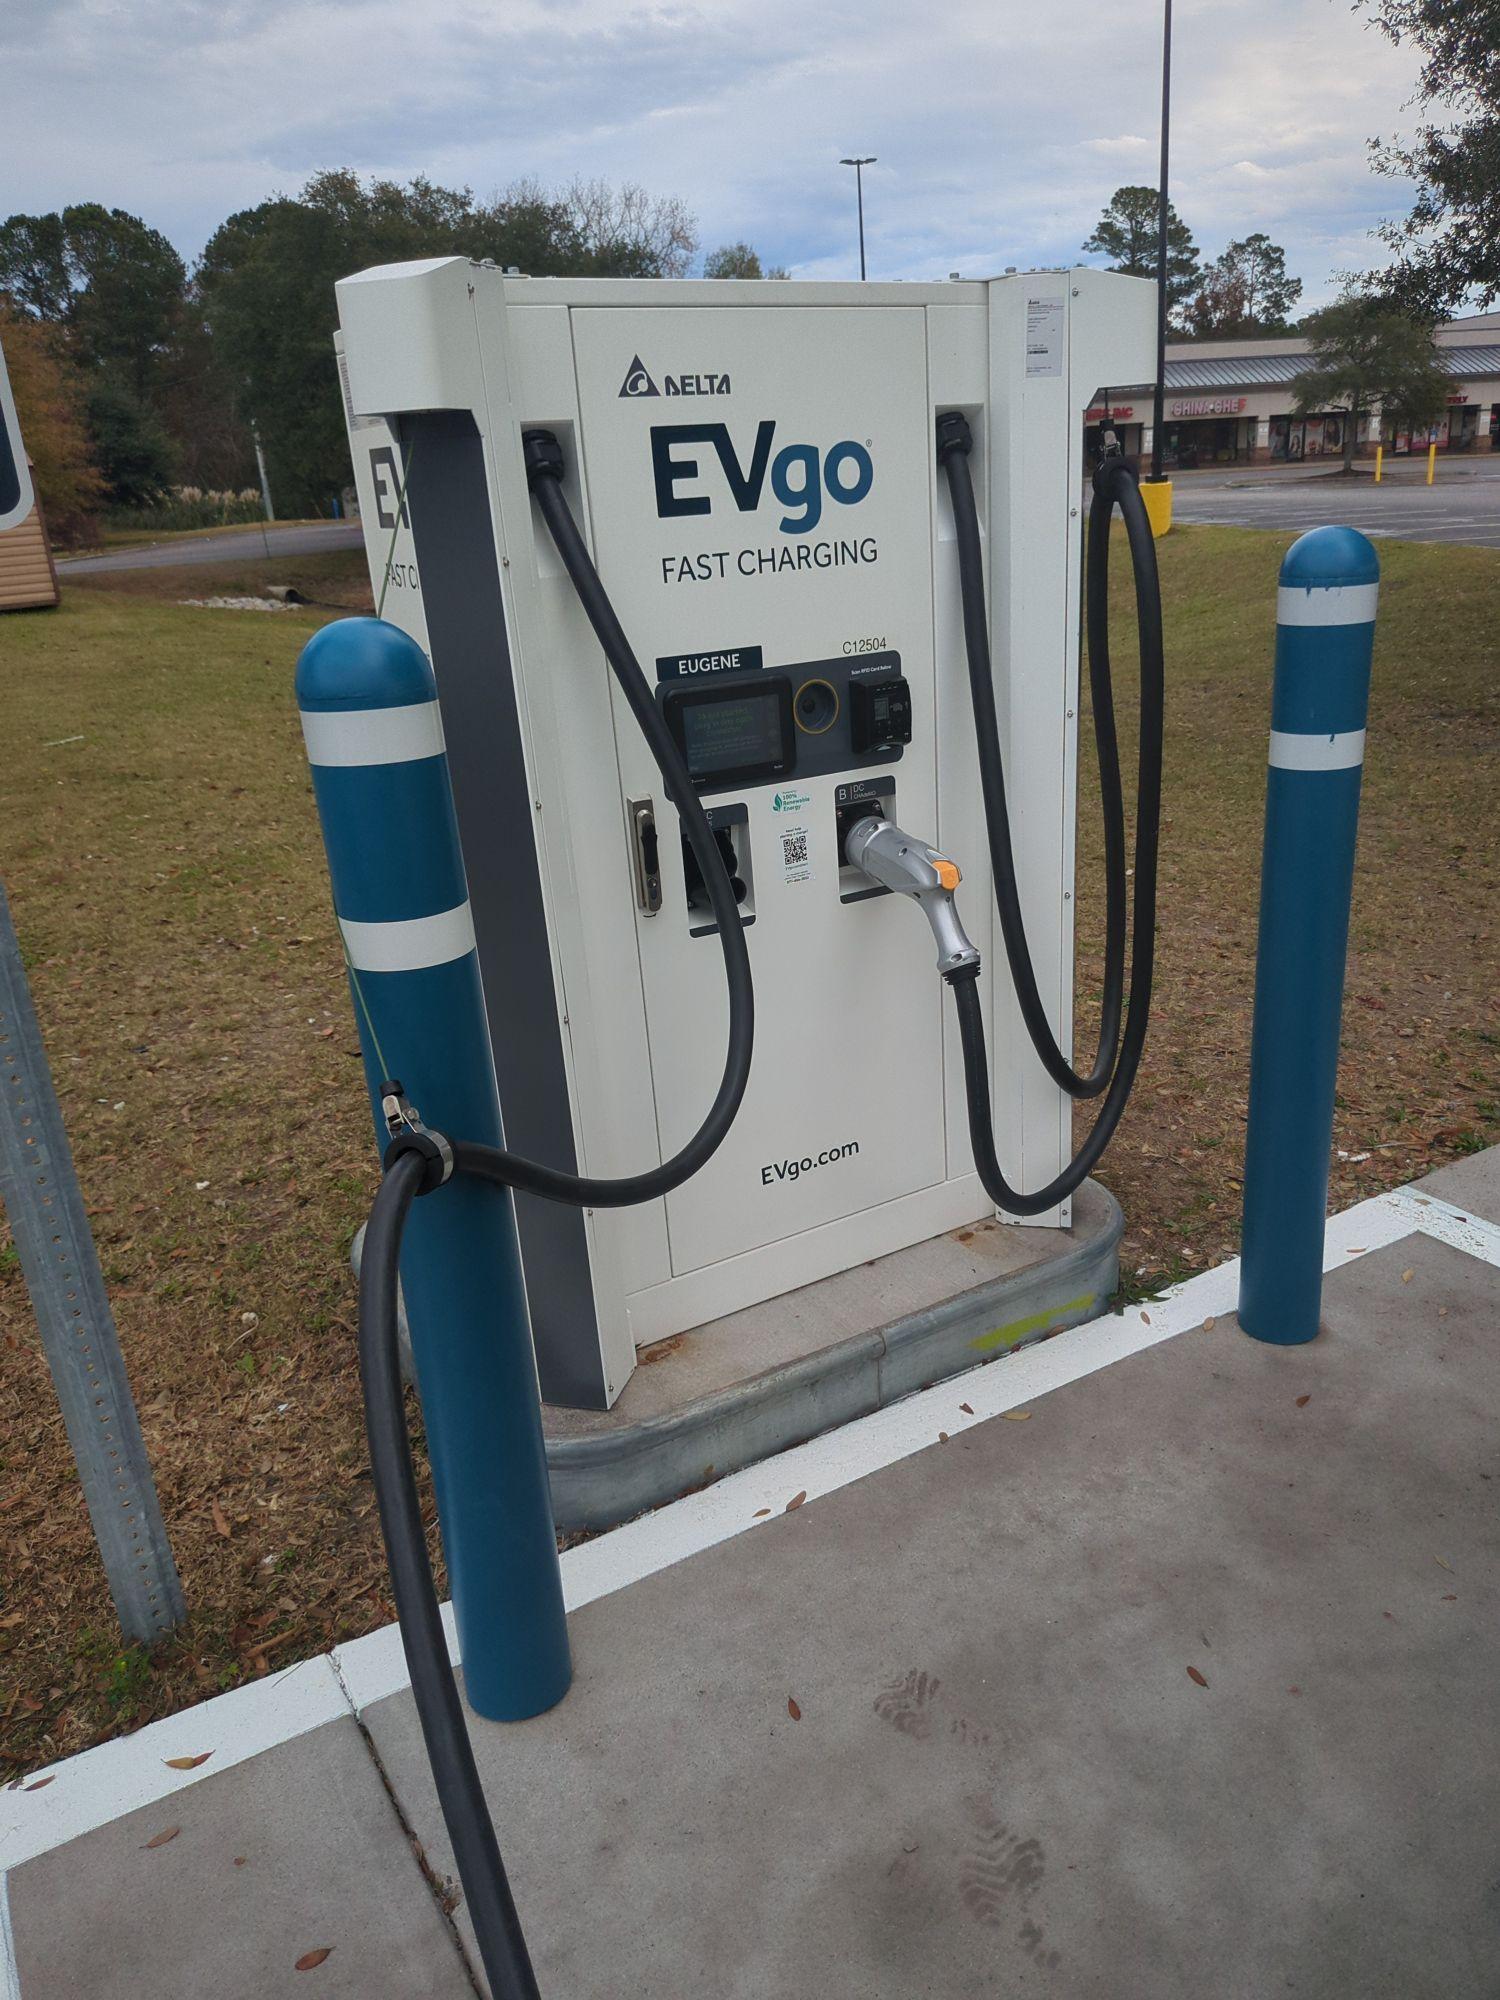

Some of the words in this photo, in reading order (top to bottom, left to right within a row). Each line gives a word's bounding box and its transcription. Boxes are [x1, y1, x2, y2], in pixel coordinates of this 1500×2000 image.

[664, 373, 731, 396] DELTA
[1172, 399, 1210, 417] CHINA
[1215, 398, 1248, 414] CHEF
[650, 420, 874, 534] EVgo
[662, 551, 730, 584] FAST
[736, 537, 878, 576] CHARGING
[842, 637, 887, 655] C12504
[678, 653, 741, 675] EUGENE
[839, 788, 847, 800] B
[853, 783, 865, 793] DC
[783, 796, 810, 806] Renewable
[783, 804, 801, 812] Energy
[761, 1141, 860, 1186] EVgo.com
